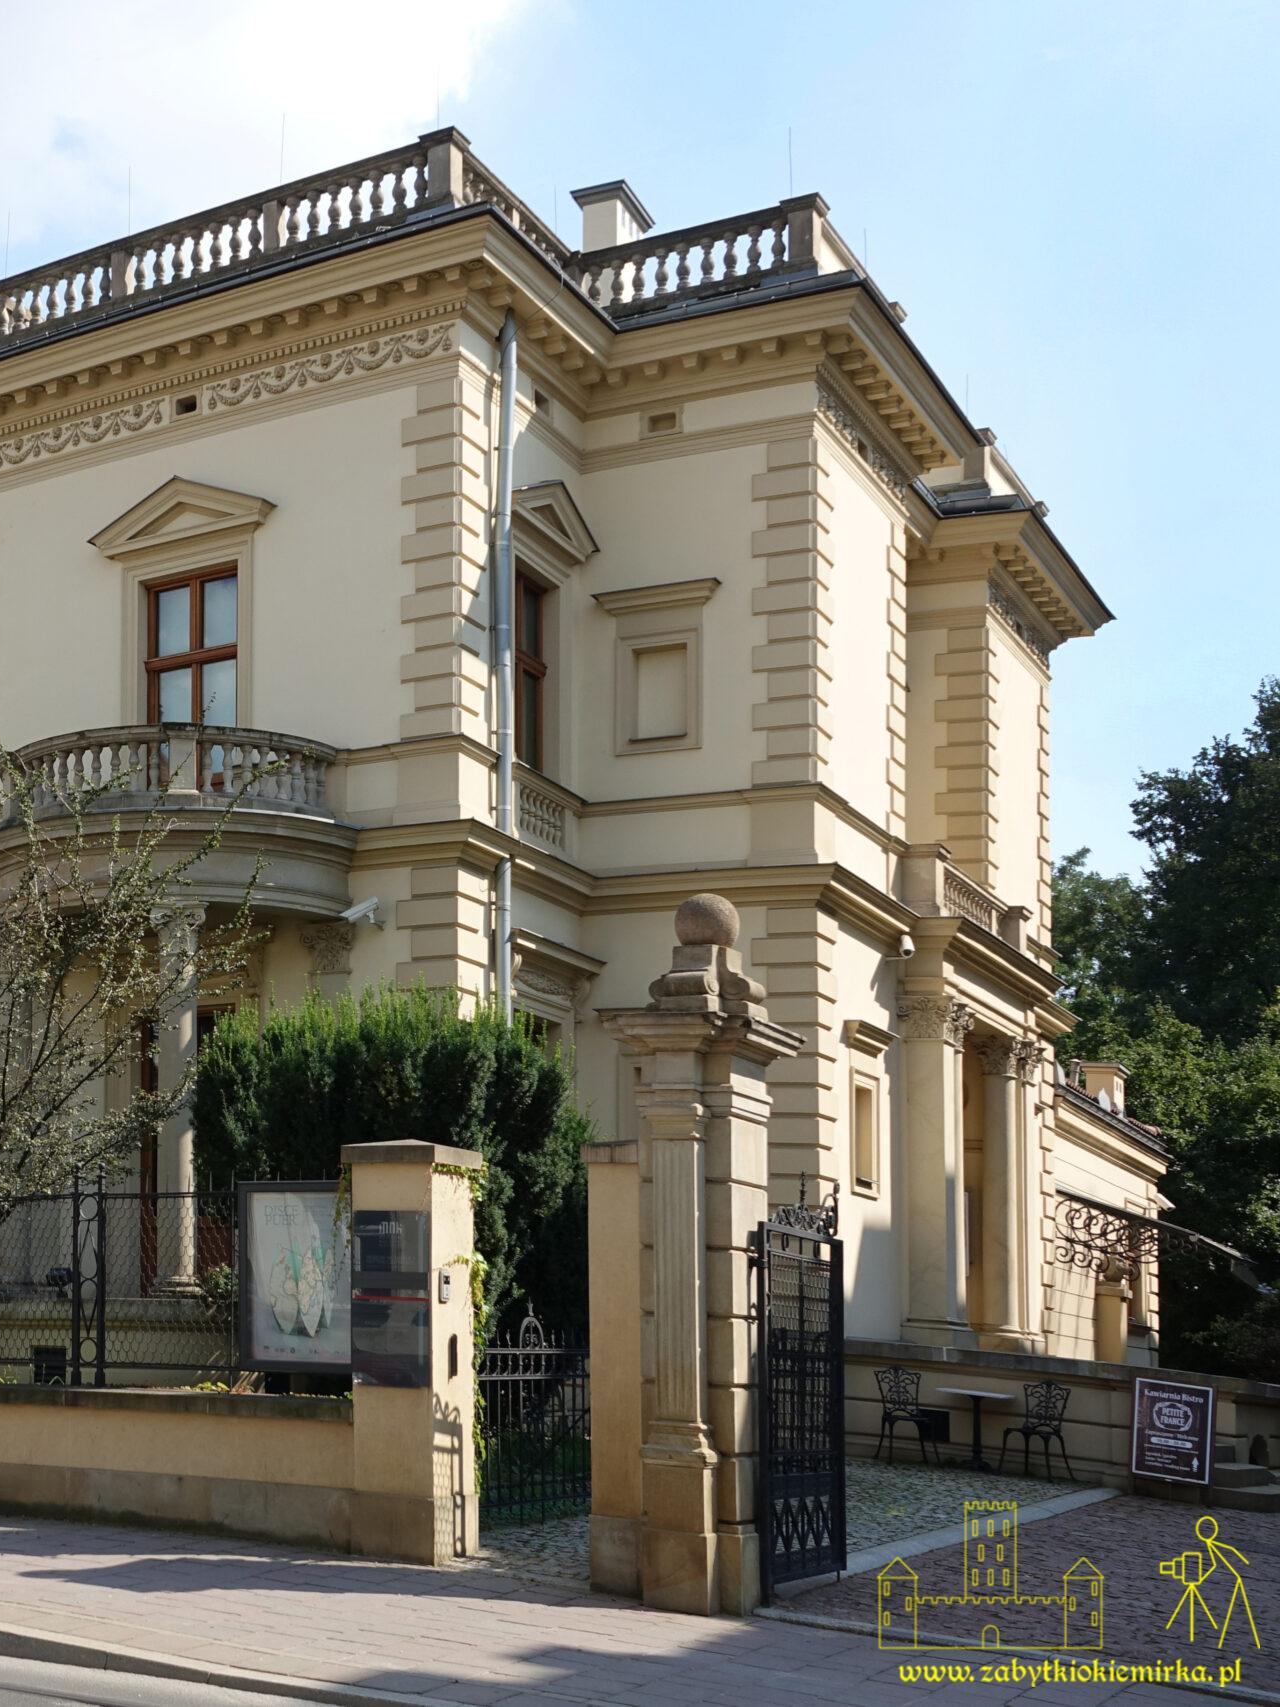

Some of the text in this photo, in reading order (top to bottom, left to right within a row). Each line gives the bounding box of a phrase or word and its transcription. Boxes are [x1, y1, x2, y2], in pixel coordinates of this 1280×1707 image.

[265, 1215, 298, 1226] PUER
[1144, 1388, 1204, 1404] Kawiarnia Bistro
[1161, 1408, 1185, 1418] PETITE
[1160, 1415, 1185, 1426] FRANCE
